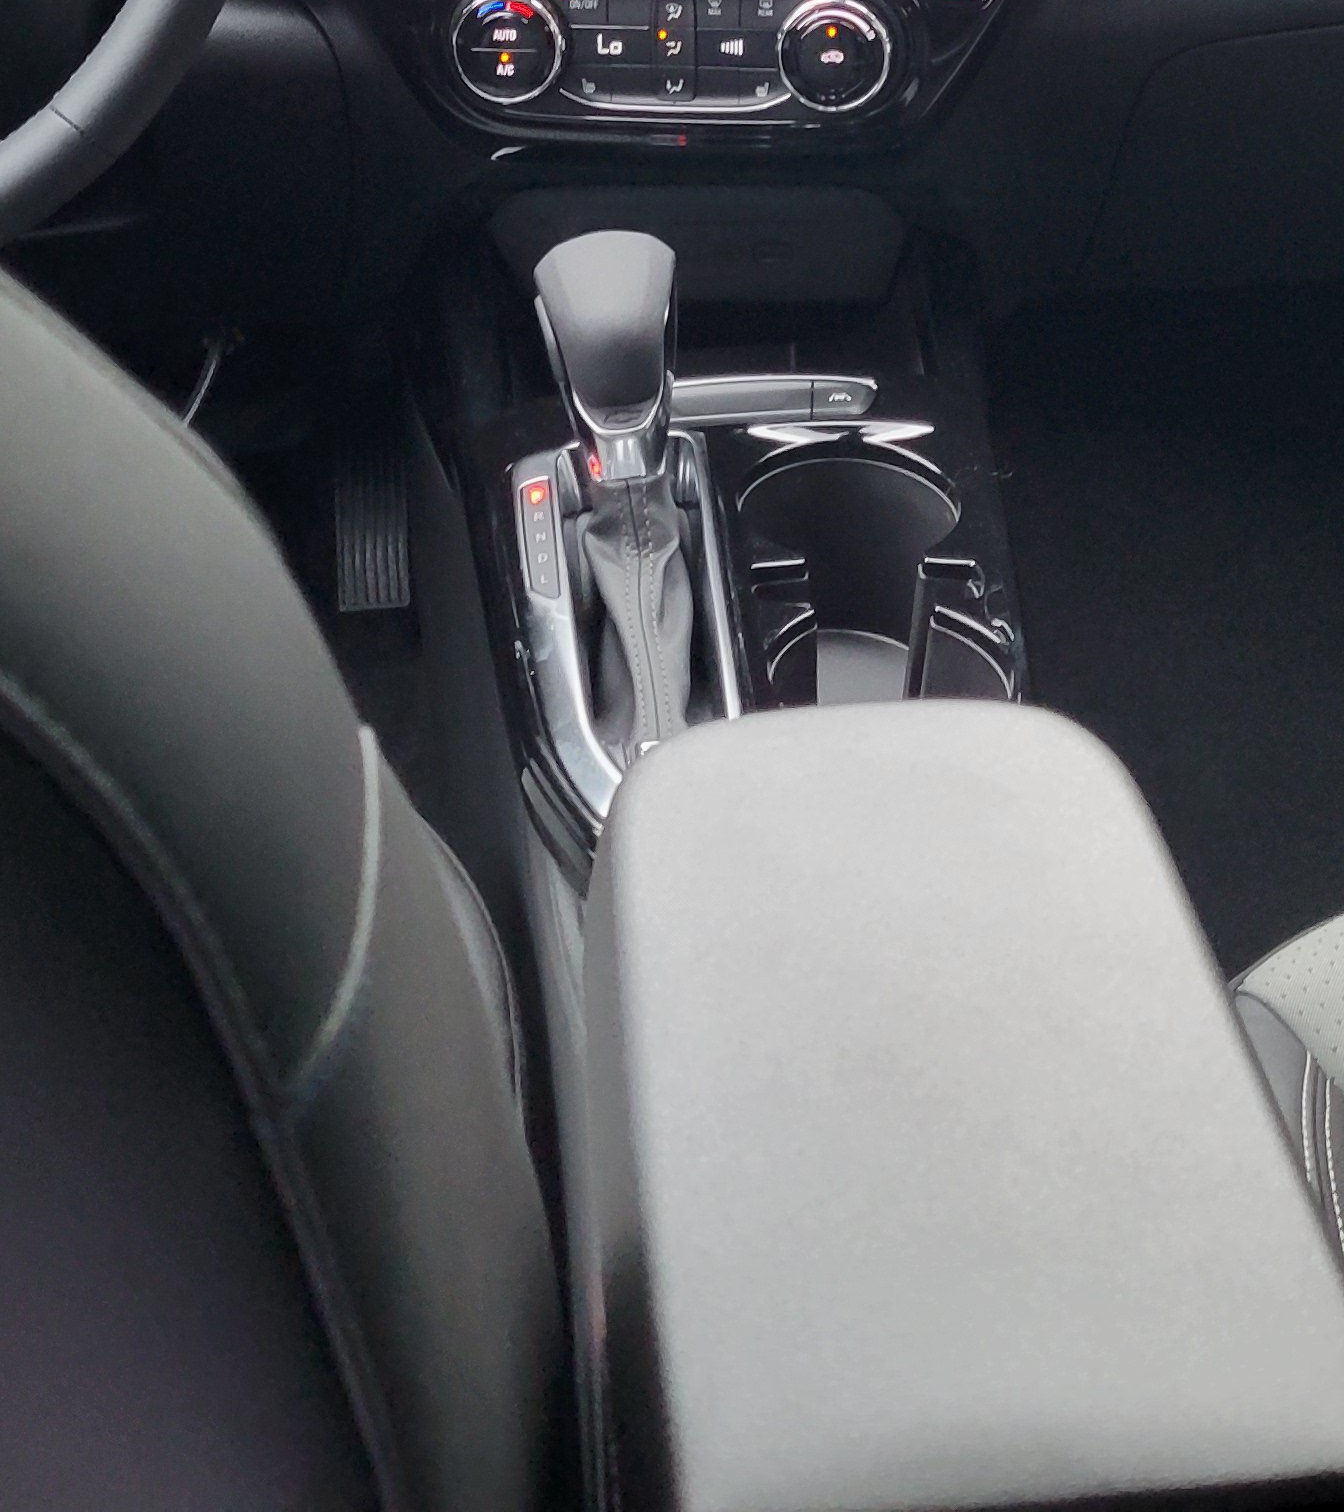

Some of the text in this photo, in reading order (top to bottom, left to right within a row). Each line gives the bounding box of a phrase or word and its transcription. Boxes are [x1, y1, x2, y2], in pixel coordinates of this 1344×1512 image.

[569, 0, 598, 9] ON/OFF
[492, 28, 517, 42] AUTO
[597, 33, 623, 55] Lo
[496, 64, 515, 76] A/C
[534, 511, 544, 522] R
[538, 552, 548, 563] D
[540, 572, 549, 584] L
